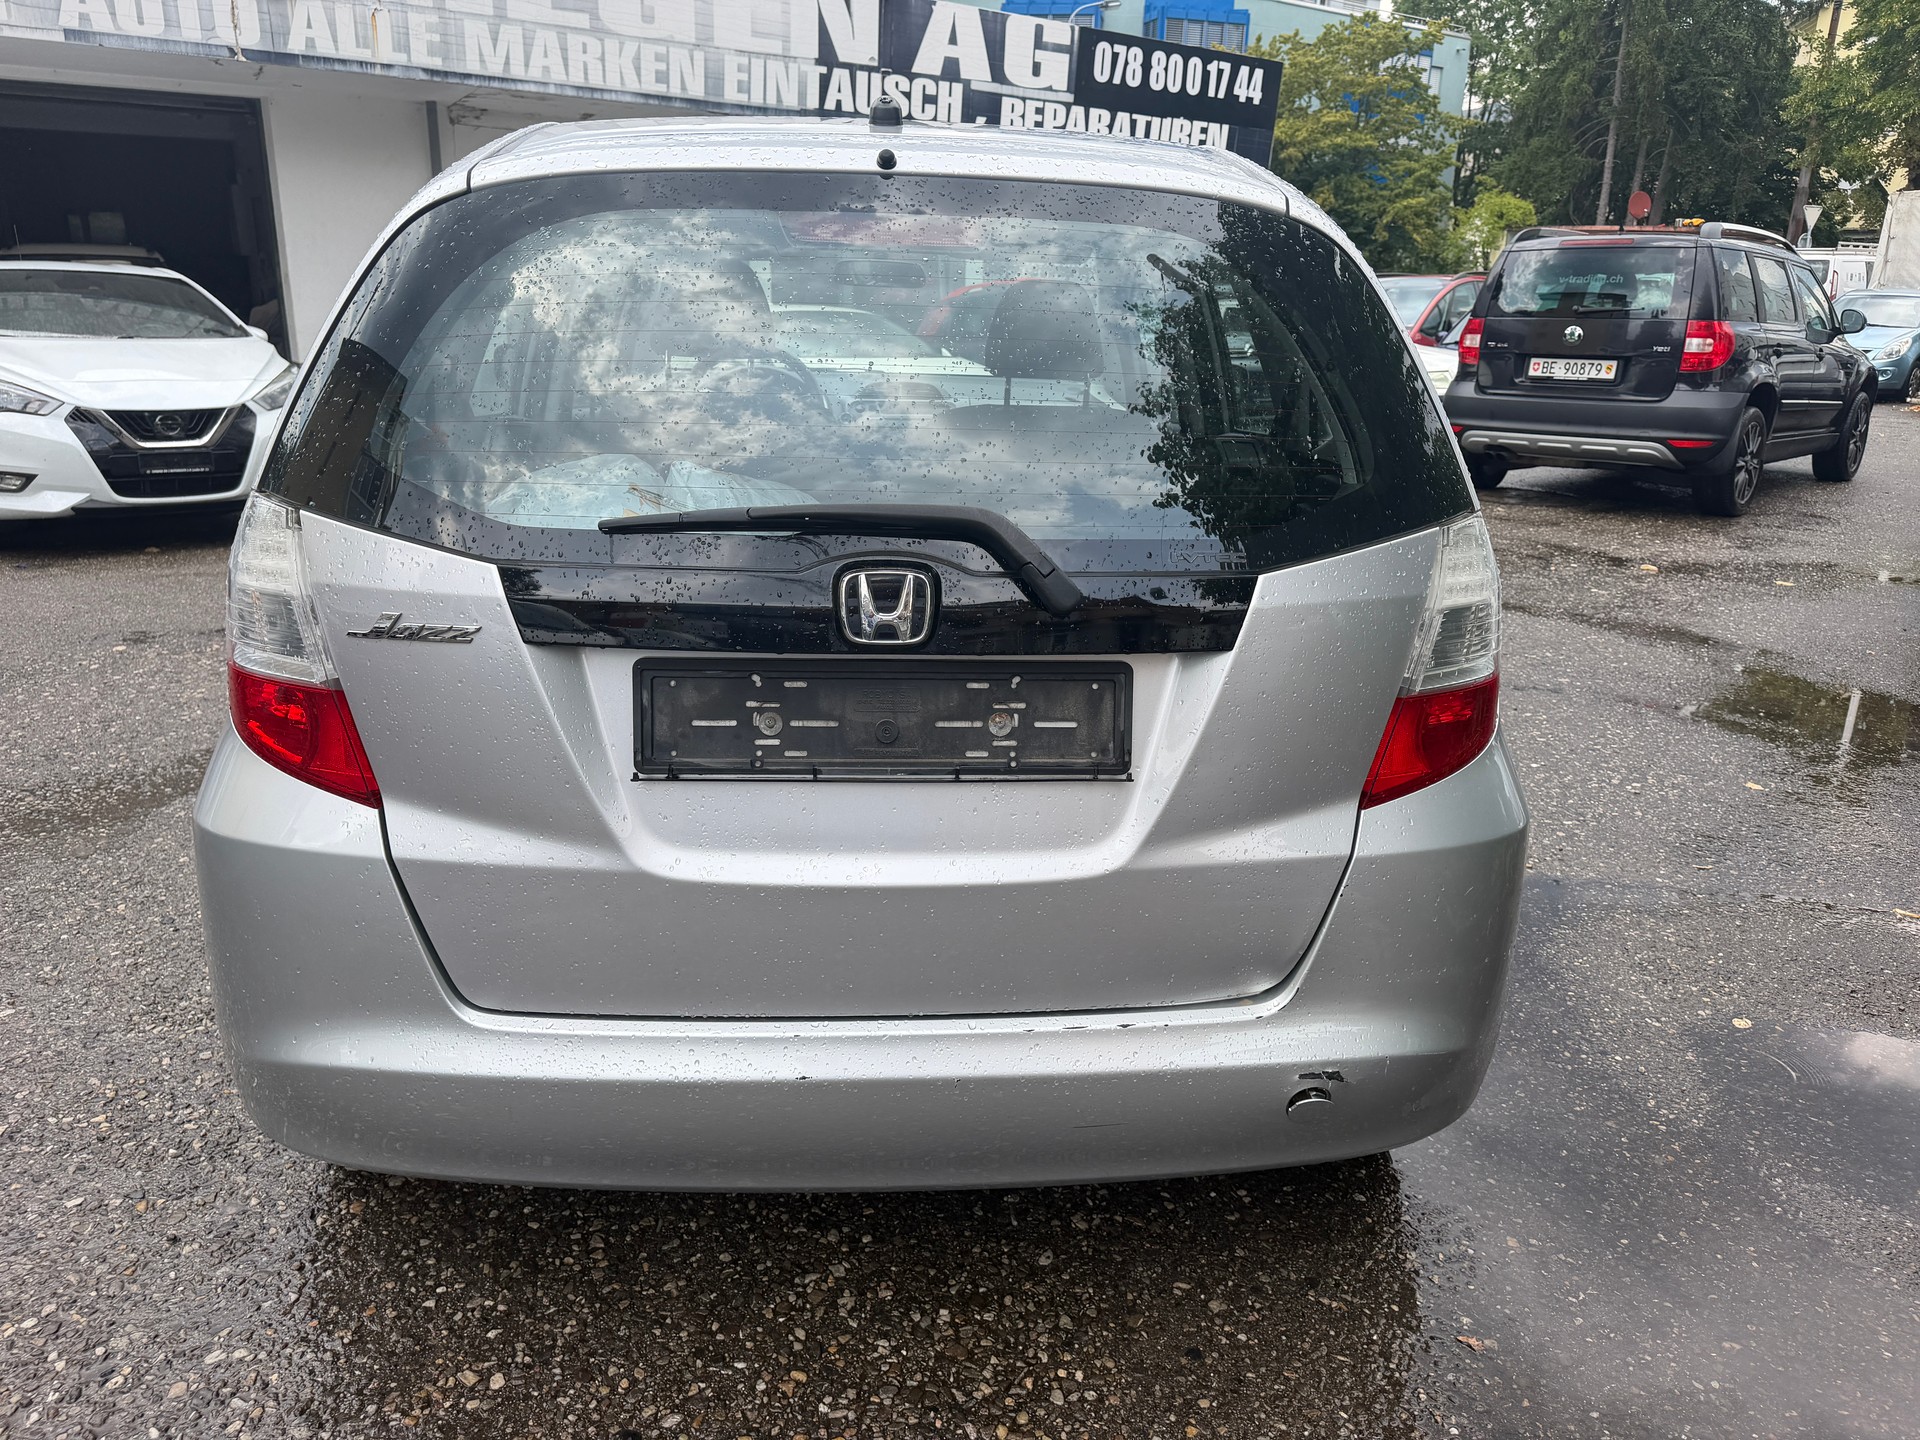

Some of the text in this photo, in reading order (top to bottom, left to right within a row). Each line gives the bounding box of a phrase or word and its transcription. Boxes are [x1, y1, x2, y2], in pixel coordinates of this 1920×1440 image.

[287, 0, 443, 66] ALLE
[463, 19, 705, 97] MARKEN
[723, 53, 964, 124] EINTAUSCH
[1000, 96, 1230, 150] REPARATUREN
[911, 0, 1074, 91] AG
[1093, 41, 1265, 105] 078 800 17 44
[346, 611, 482, 644] Jazz
